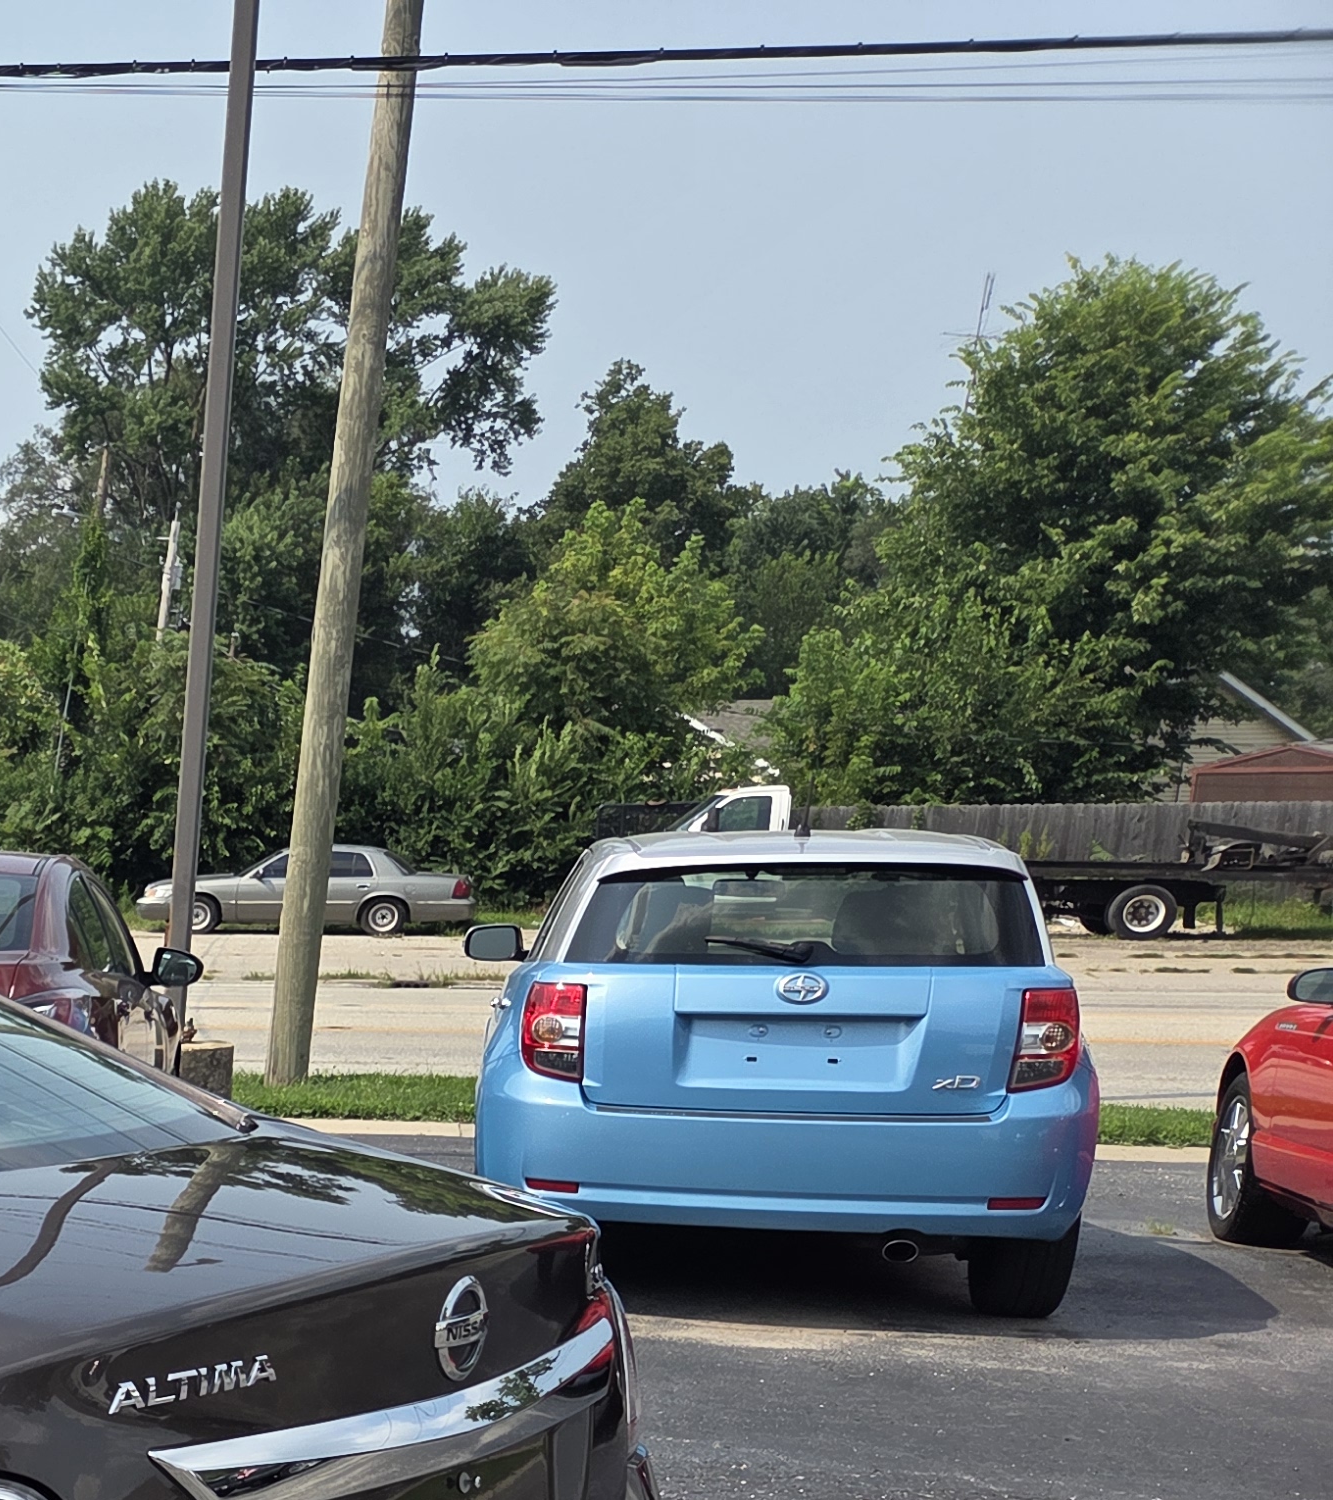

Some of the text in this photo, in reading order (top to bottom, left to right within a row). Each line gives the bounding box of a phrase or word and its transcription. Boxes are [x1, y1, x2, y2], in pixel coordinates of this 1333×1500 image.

[931, 1074, 981, 1090] xD
[446, 1317, 487, 1342] NISSA
[108, 1354, 276, 1415] ALTIMA
